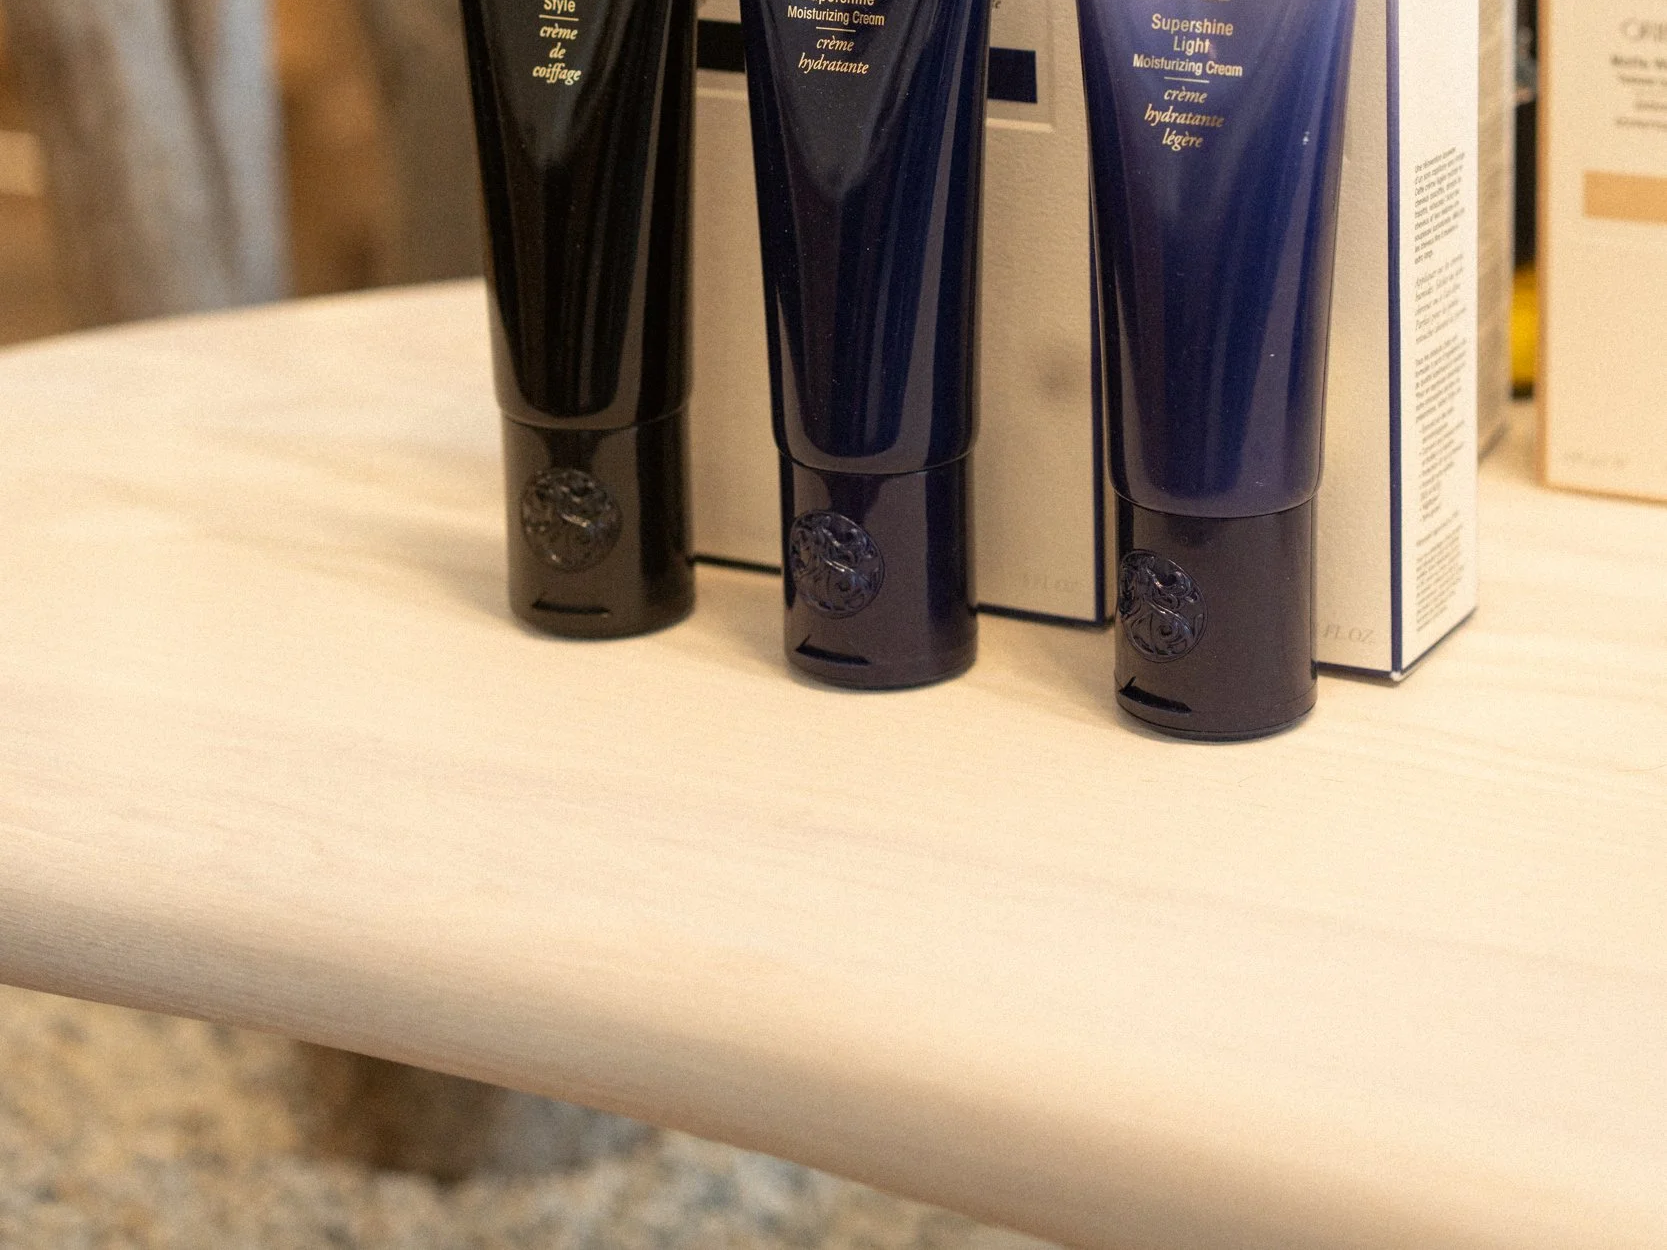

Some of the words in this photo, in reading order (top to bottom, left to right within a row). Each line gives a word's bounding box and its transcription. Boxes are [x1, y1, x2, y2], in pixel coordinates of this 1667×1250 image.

[787, 5, 851, 25] Moisturizing
[852, 10, 885, 26] Cream
[1151, 13, 1234, 36] Supershine
[539, 23, 578, 41] crème
[549, 43, 566, 59] de
[816, 35, 855, 52] crème
[1173, 36, 1211, 56] Light
[532, 63, 582, 86] coiffage
[798, 52, 870, 75] hydratante
[1133, 53, 1203, 76] Moisturizing
[1205, 60, 1243, 77] Cream
[1163, 86, 1208, 103] crème
[1144, 103, 1225, 128] hydratante
[1162, 128, 1203, 151] légère
